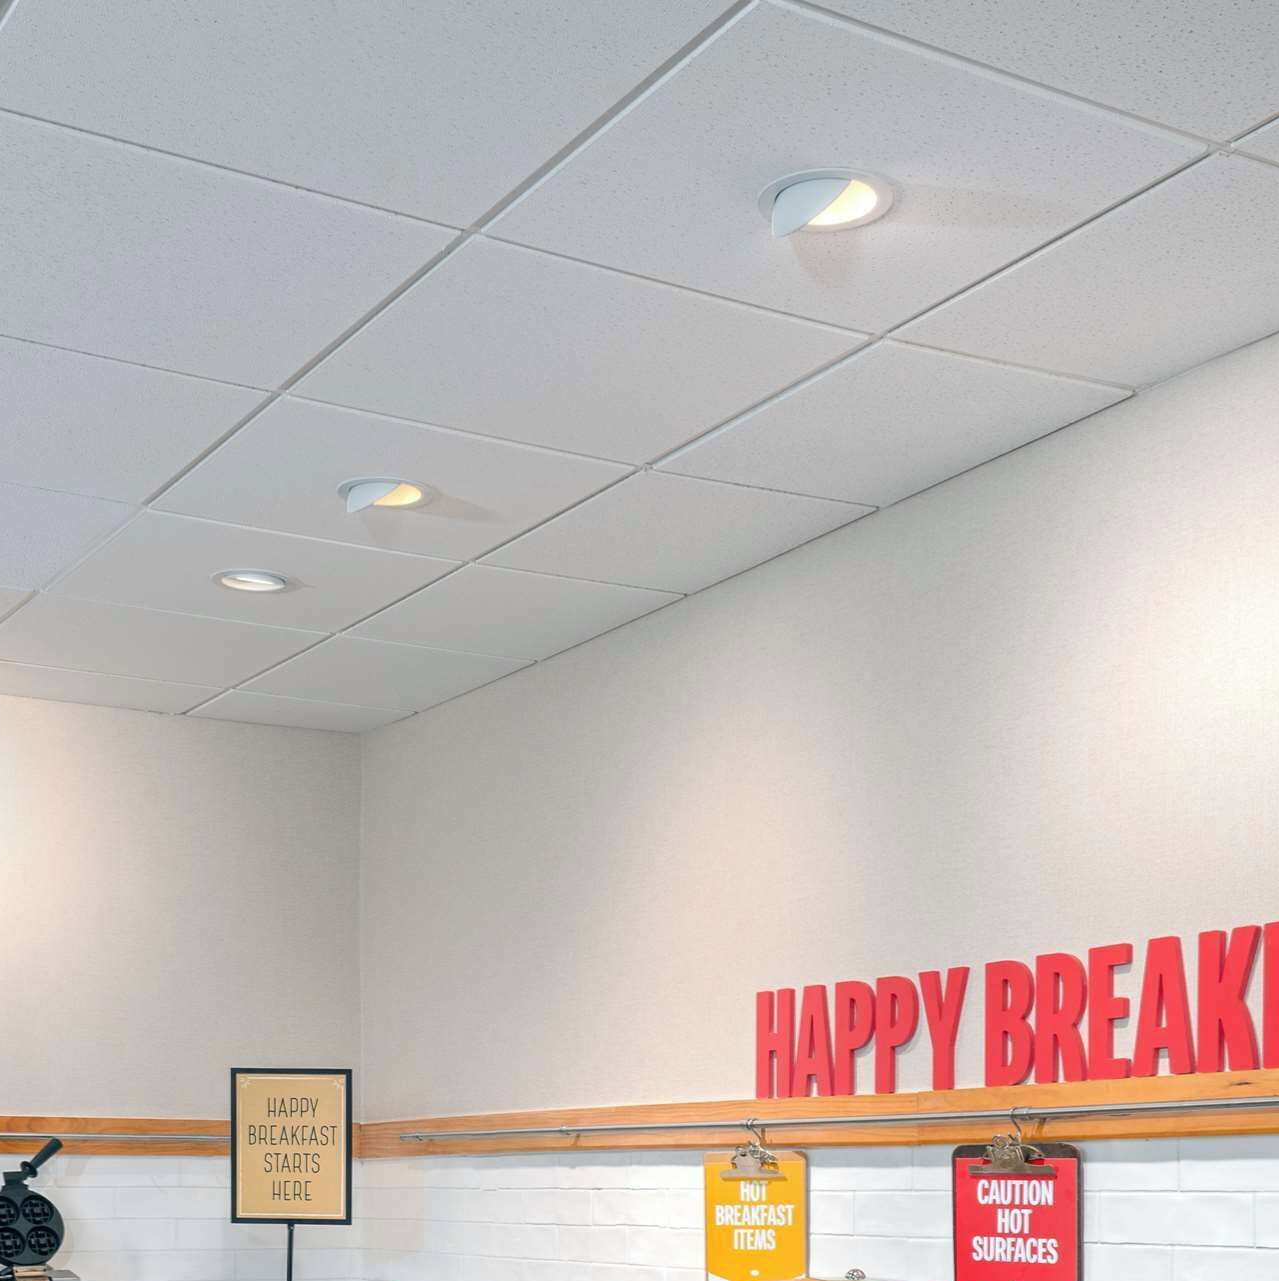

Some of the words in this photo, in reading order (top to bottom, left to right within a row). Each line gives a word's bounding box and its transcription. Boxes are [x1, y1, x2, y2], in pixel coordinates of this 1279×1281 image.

[755, 966, 970, 1099] HAPPY
[267, 1097, 319, 1118] HAPPY
[248, 1124, 337, 1146] BREAKFAST
[264, 1152, 321, 1174] STARTS
[272, 1180, 313, 1201] HERE
[740, 1180, 768, 1202] HOT
[977, 1179, 1054, 1206] CAUTION
[715, 1204, 795, 1226] BREAKFAST
[997, 1208, 1032, 1234] HOT
[733, 1228, 776, 1250] ITEMS
[972, 1236, 1059, 1264] SURFACES
